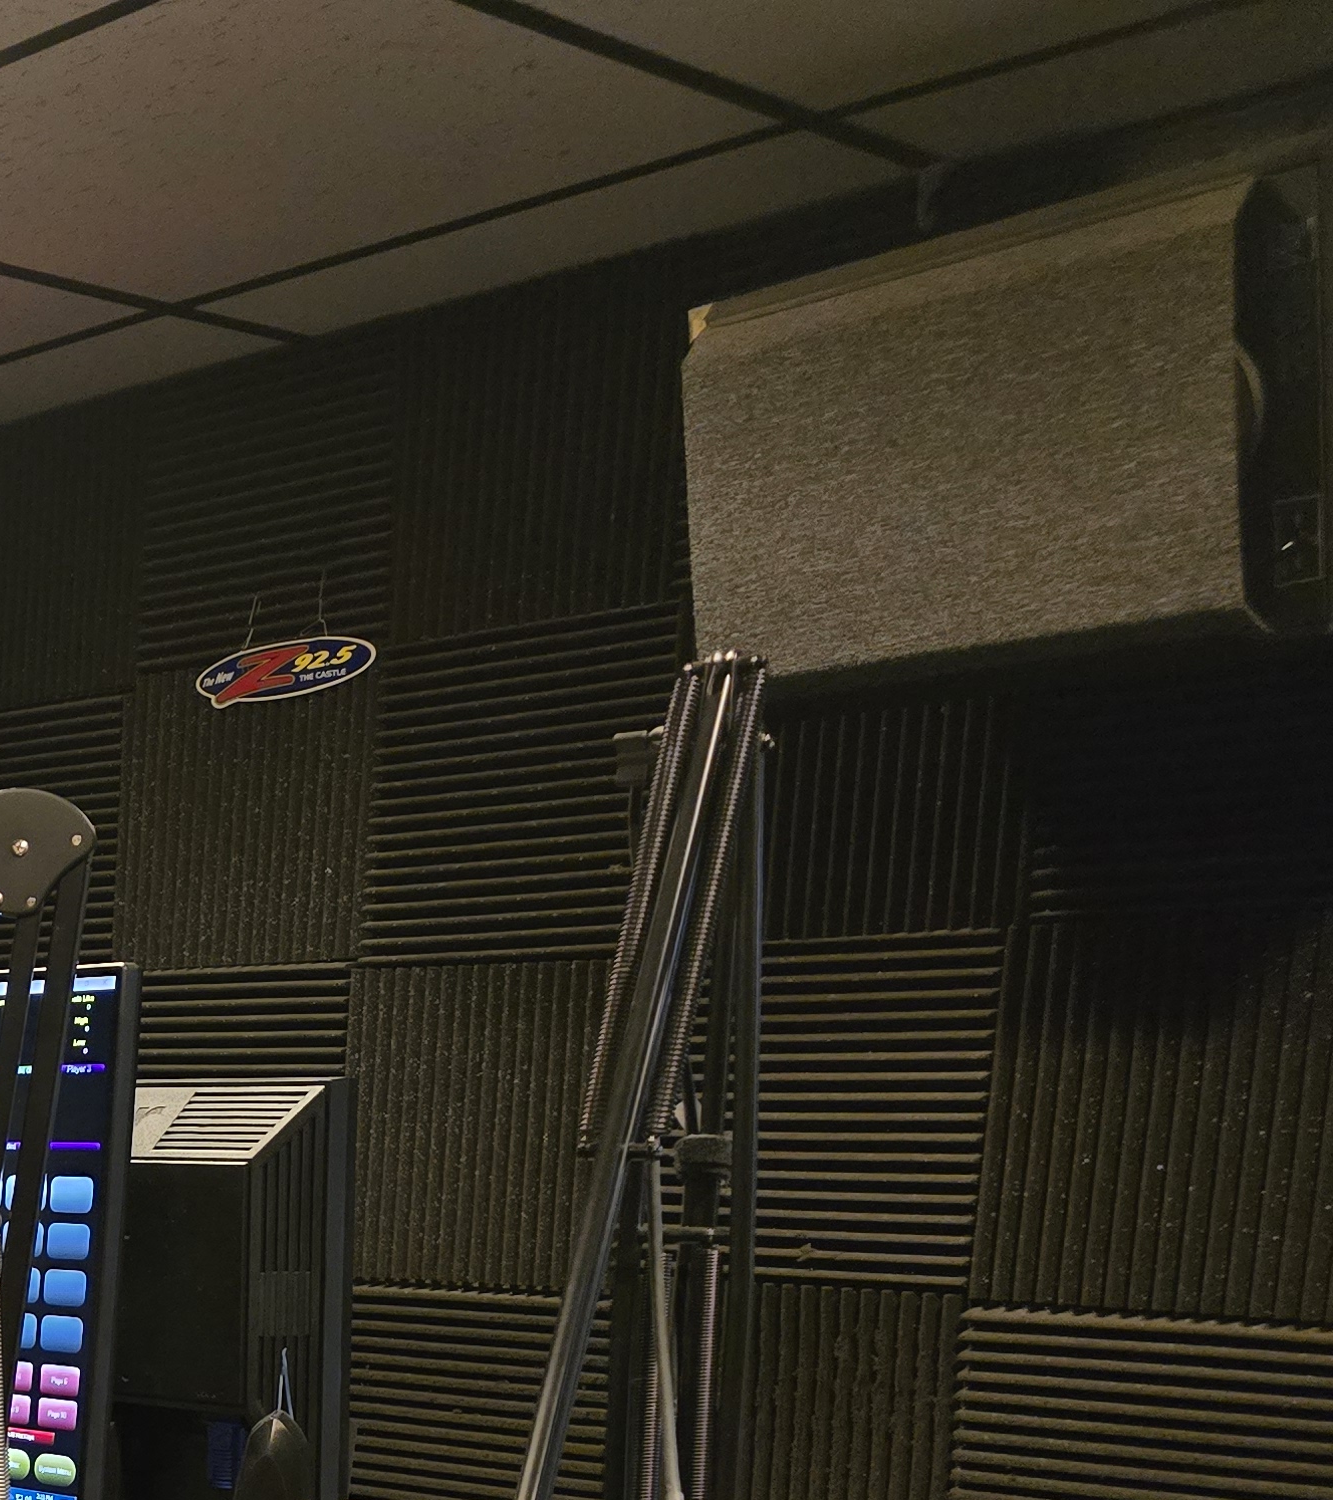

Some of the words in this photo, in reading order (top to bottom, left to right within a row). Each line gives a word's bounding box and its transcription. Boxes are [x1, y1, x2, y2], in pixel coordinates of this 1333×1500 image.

[291, 644, 357, 673] 92.5
[215, 645, 310, 703] Z
[215, 669, 235, 685] New
[299, 673, 314, 682] THE
[315, 668, 347, 679] CASTLE
[66, 1064, 85, 1074] Player
